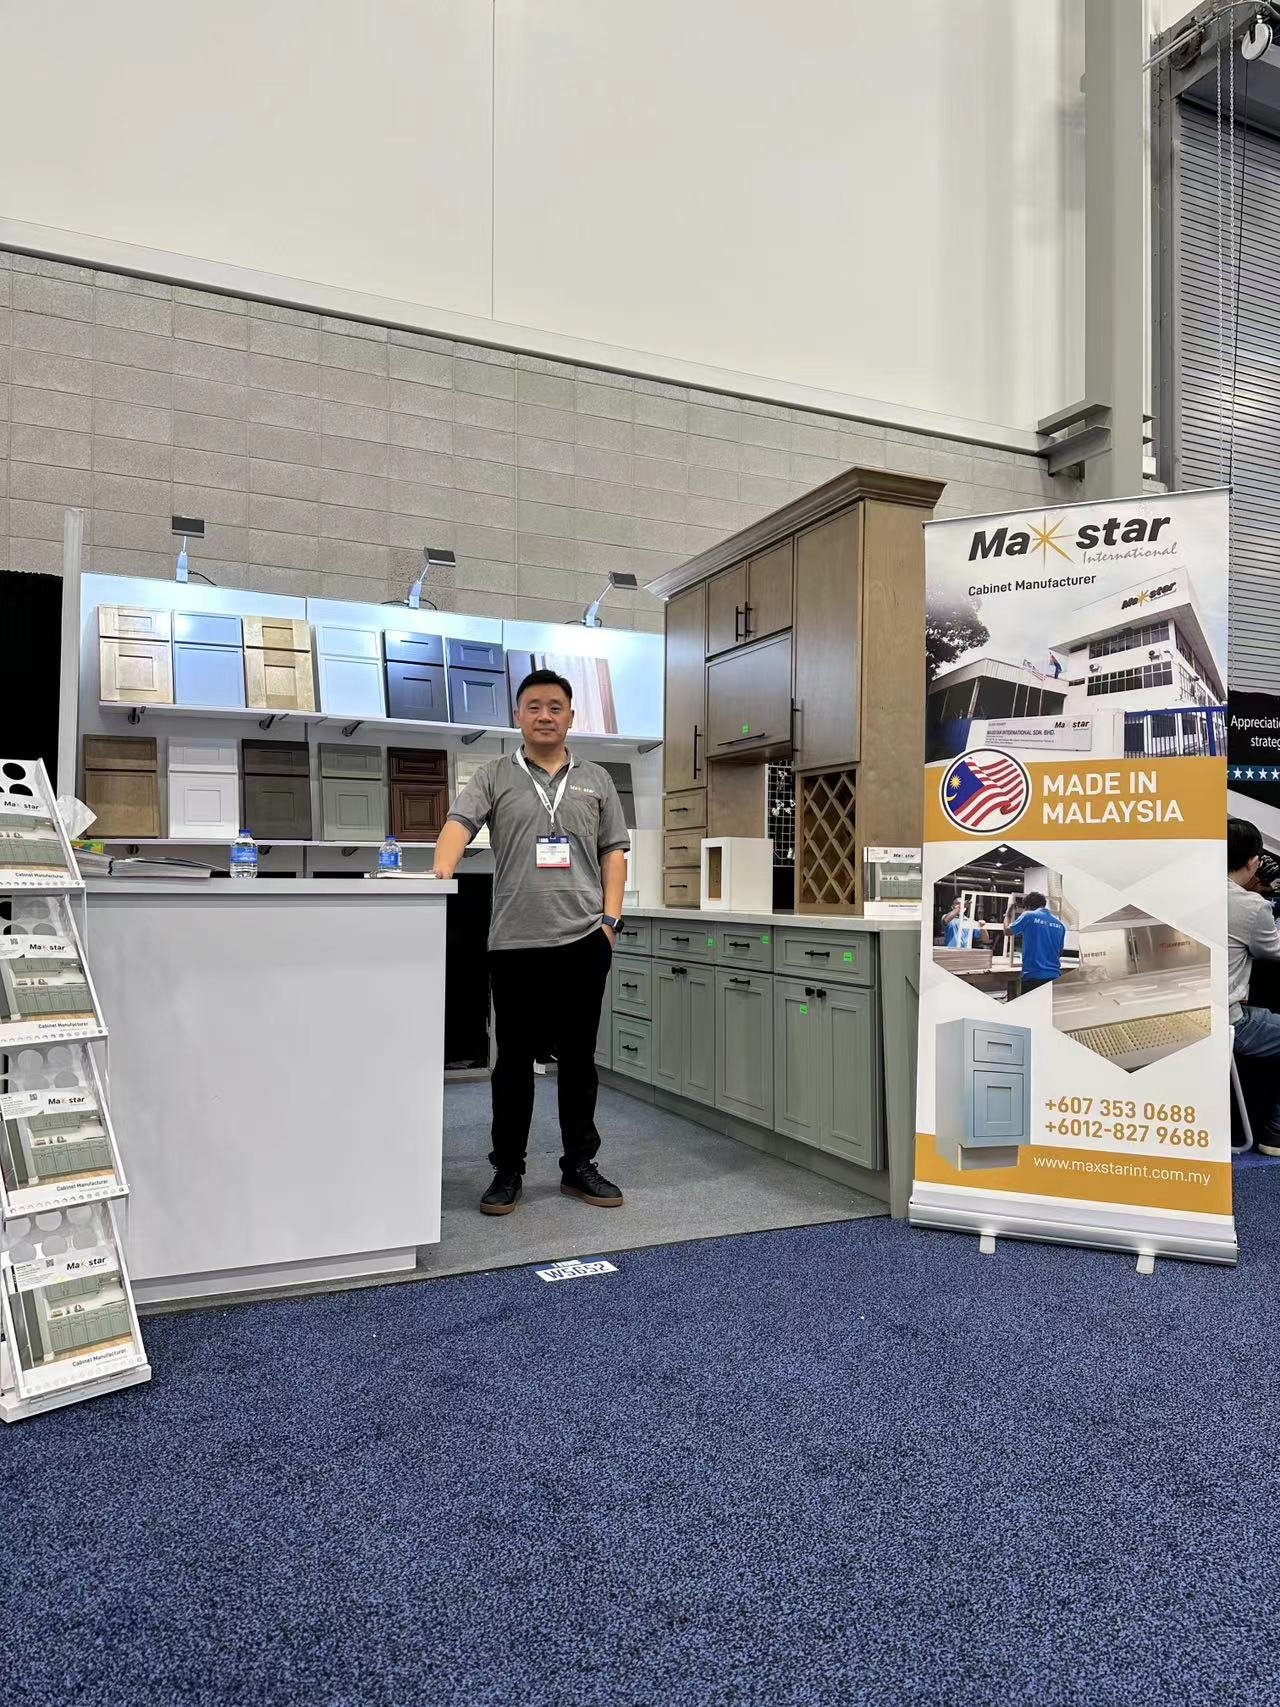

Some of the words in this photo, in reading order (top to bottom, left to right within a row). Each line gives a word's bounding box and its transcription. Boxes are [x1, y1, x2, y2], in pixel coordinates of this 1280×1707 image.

[1083, 542, 1178, 564] International
[968, 582, 1012, 596] Cabinet
[1015, 575, 1097, 591] Manufacturer
[1043, 772, 1121, 797] MADE
[1129, 771, 1157, 794] IN
[1042, 799, 1185, 824] MALAYSIA
[1045, 1095, 1094, 1115] +607
[1100, 1099, 1136, 1119] 353
[1143, 1102, 1196, 1124] 0688
[1045, 1118, 1149, 1142] +6012-827
[1156, 1126, 1209, 1148] 9688
[1033, 1156, 1211, 1185] www.maxstarint.com.my
